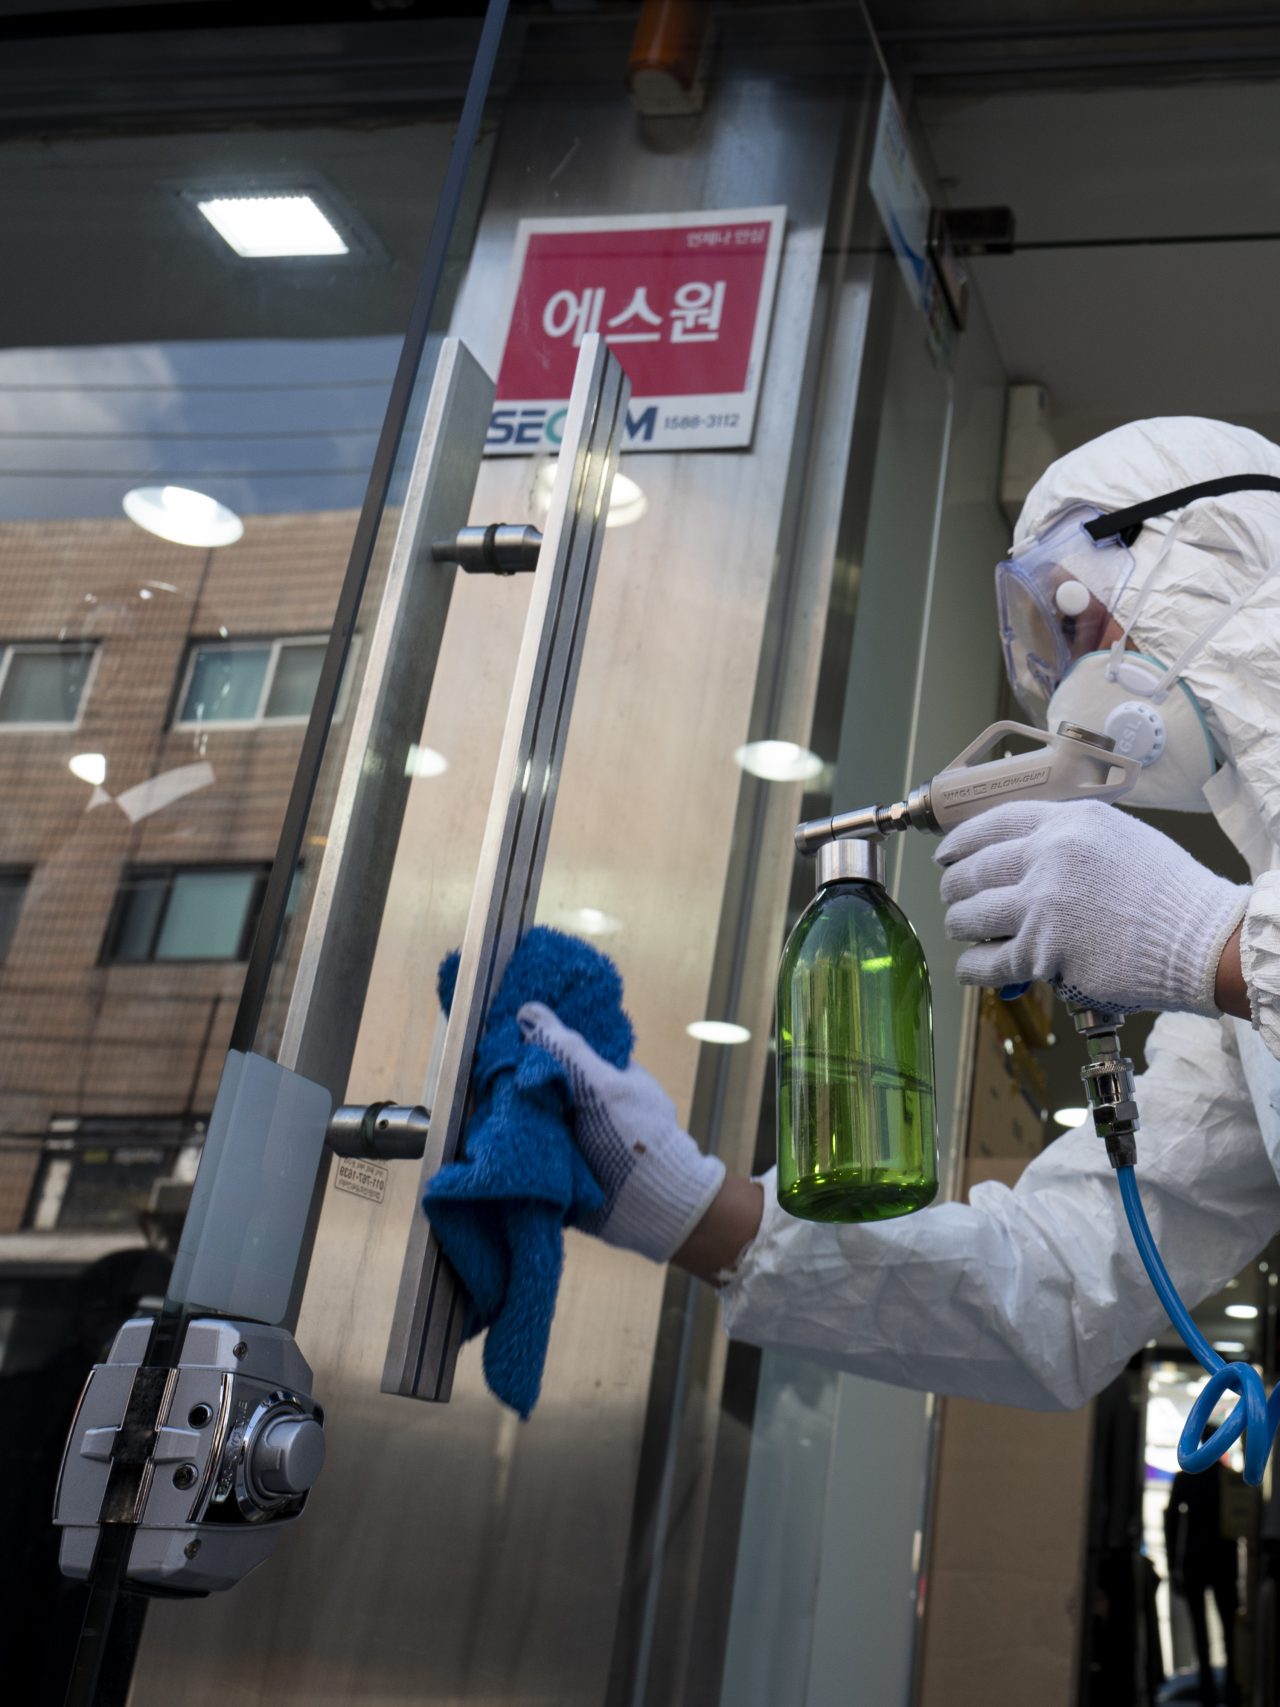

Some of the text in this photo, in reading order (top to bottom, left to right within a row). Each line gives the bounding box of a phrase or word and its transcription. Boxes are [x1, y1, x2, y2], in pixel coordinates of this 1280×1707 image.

[735, 228, 765, 245] 안심
[542, 281, 726, 348] 에스원
[486, 406, 659, 445] SECM
[664, 412, 740, 430] 1588-3112
[1120, 720, 1142, 753] GSL
